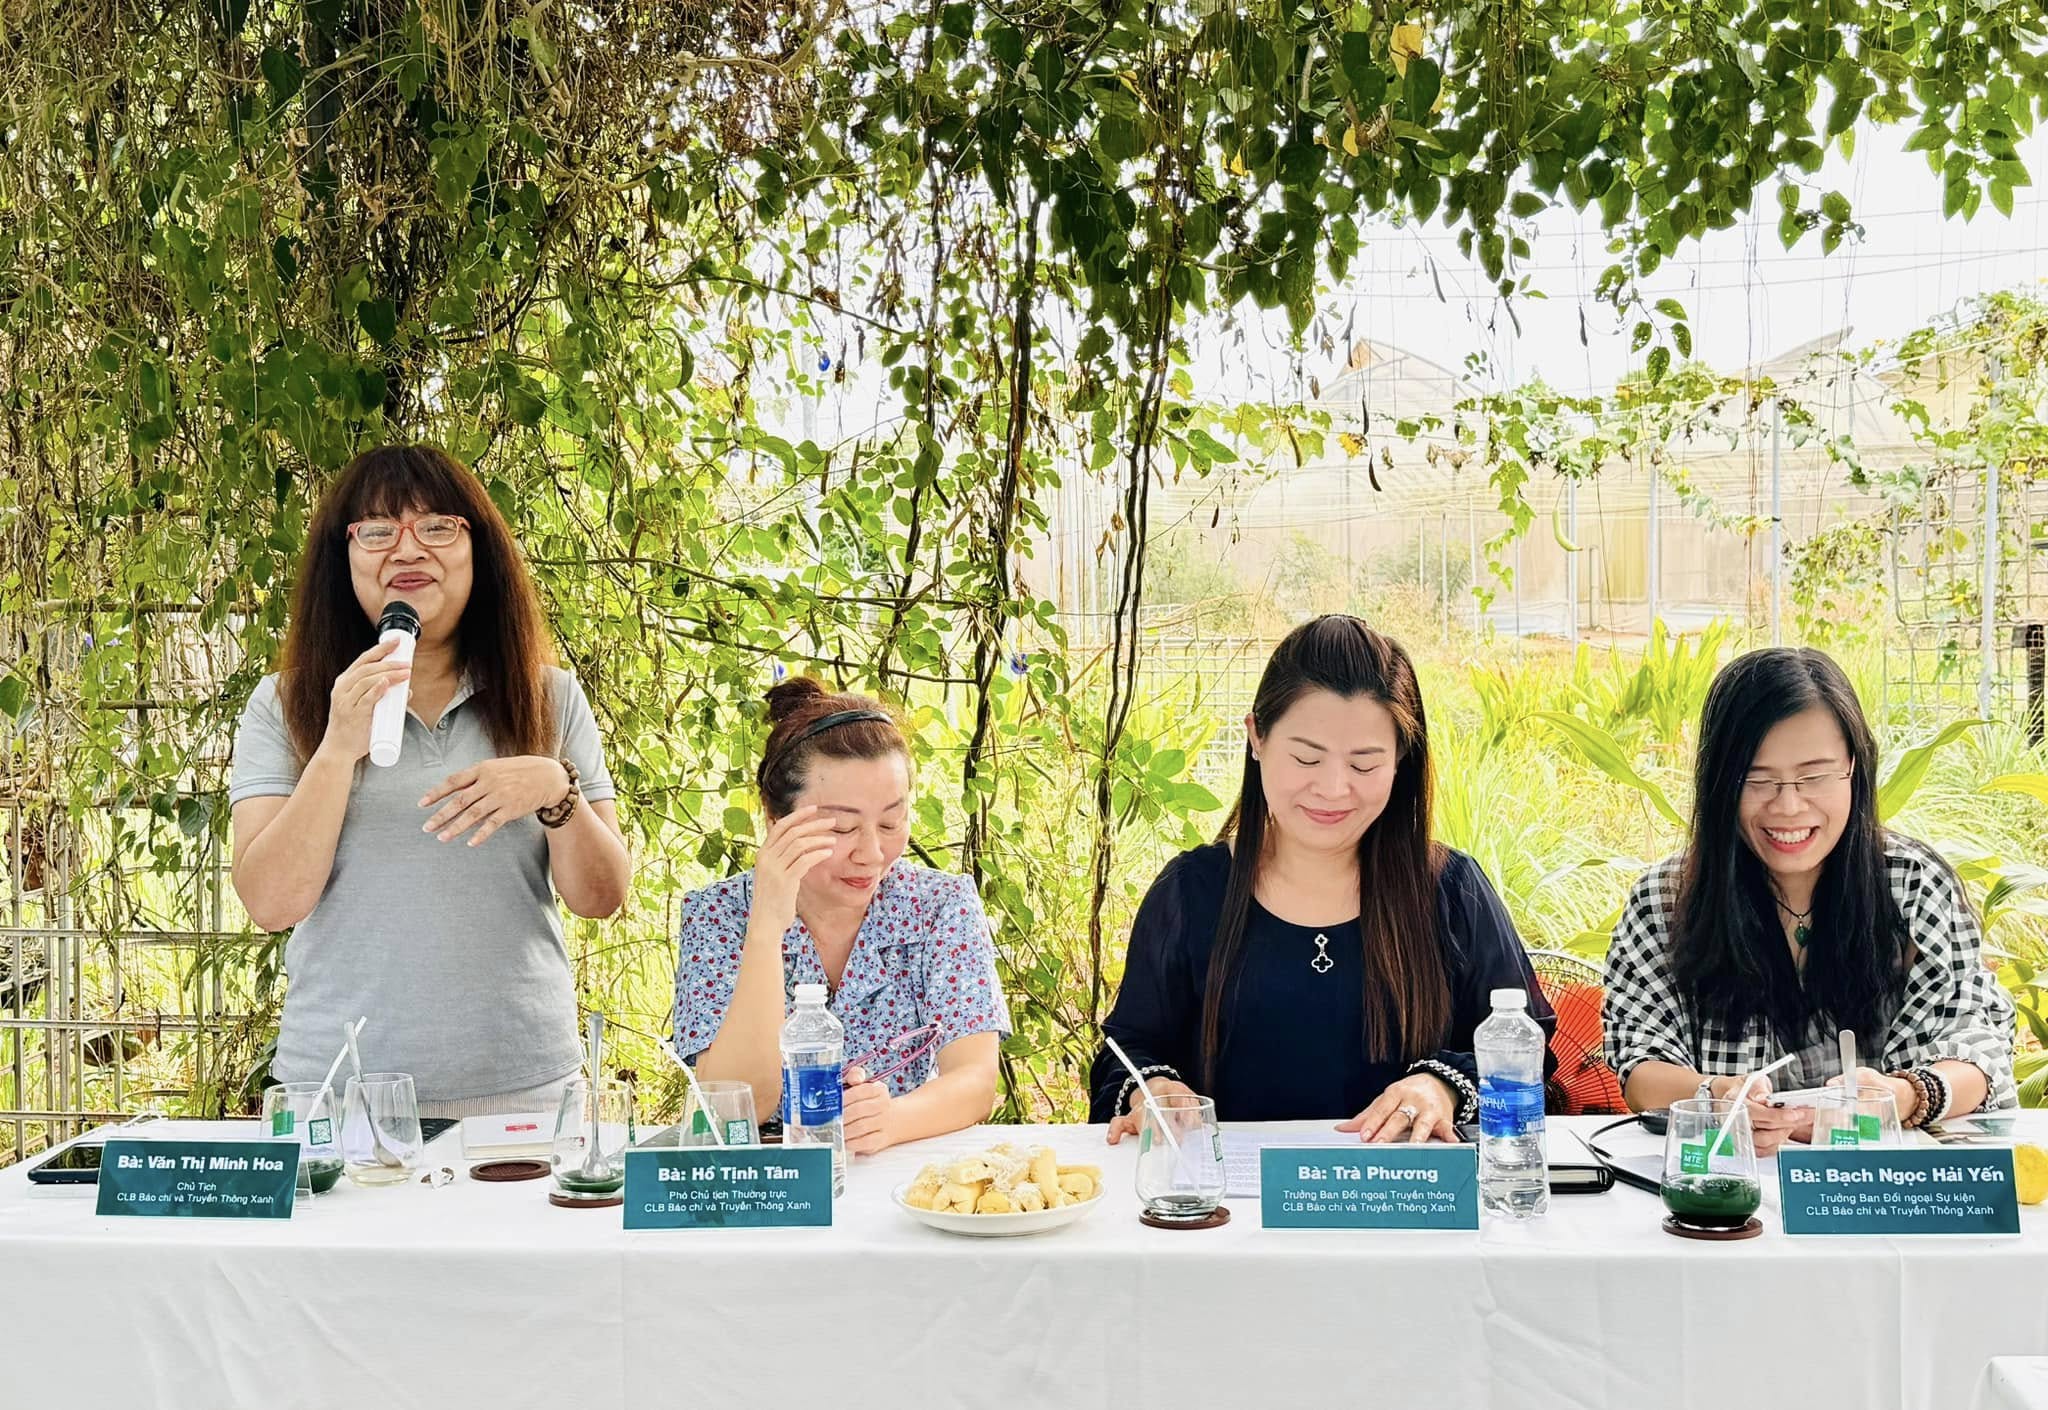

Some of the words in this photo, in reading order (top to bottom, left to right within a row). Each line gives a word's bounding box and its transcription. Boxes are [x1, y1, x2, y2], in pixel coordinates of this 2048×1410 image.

[117, 1154, 143, 1170] Bà:
[147, 1154, 176, 1170] Văn
[180, 1154, 205, 1173] Thị
[209, 1155, 248, 1171] Minh
[252, 1156, 284, 1172] Hoa
[658, 1166, 686, 1182] Bà:
[691, 1165, 716, 1181] Hồ
[720, 1166, 758, 1184] Tịnh
[763, 1165, 800, 1180] Tâm
[1298, 1165, 1328, 1181] Bà:
[1332, 1165, 1361, 1181] Trà
[1366, 1165, 1439, 1183] Phương
[1789, 1167, 1822, 1183] Bà:
[1825, 1167, 1874, 1187] Bạch
[1879, 1168, 1928, 1186] Ngọc
[1932, 1165, 1964, 1183] Hải
[1966, 1165, 2005, 1183] Yến
[117, 1192, 136, 1202] CLB
[250, 1194, 274, 1204] Xanh
[1319, 1190, 1339, 1200] Ban
[1859, 1193, 1880, 1203] Ban
[644, 1203, 665, 1212] CLB
[786, 1200, 811, 1210] Xanh
[1282, 1202, 1304, 1212] CLB
[1430, 1203, 1456, 1212] Xanh
[1806, 1206, 1830, 1216] CLB
[1966, 1205, 1994, 1215] Xanh
